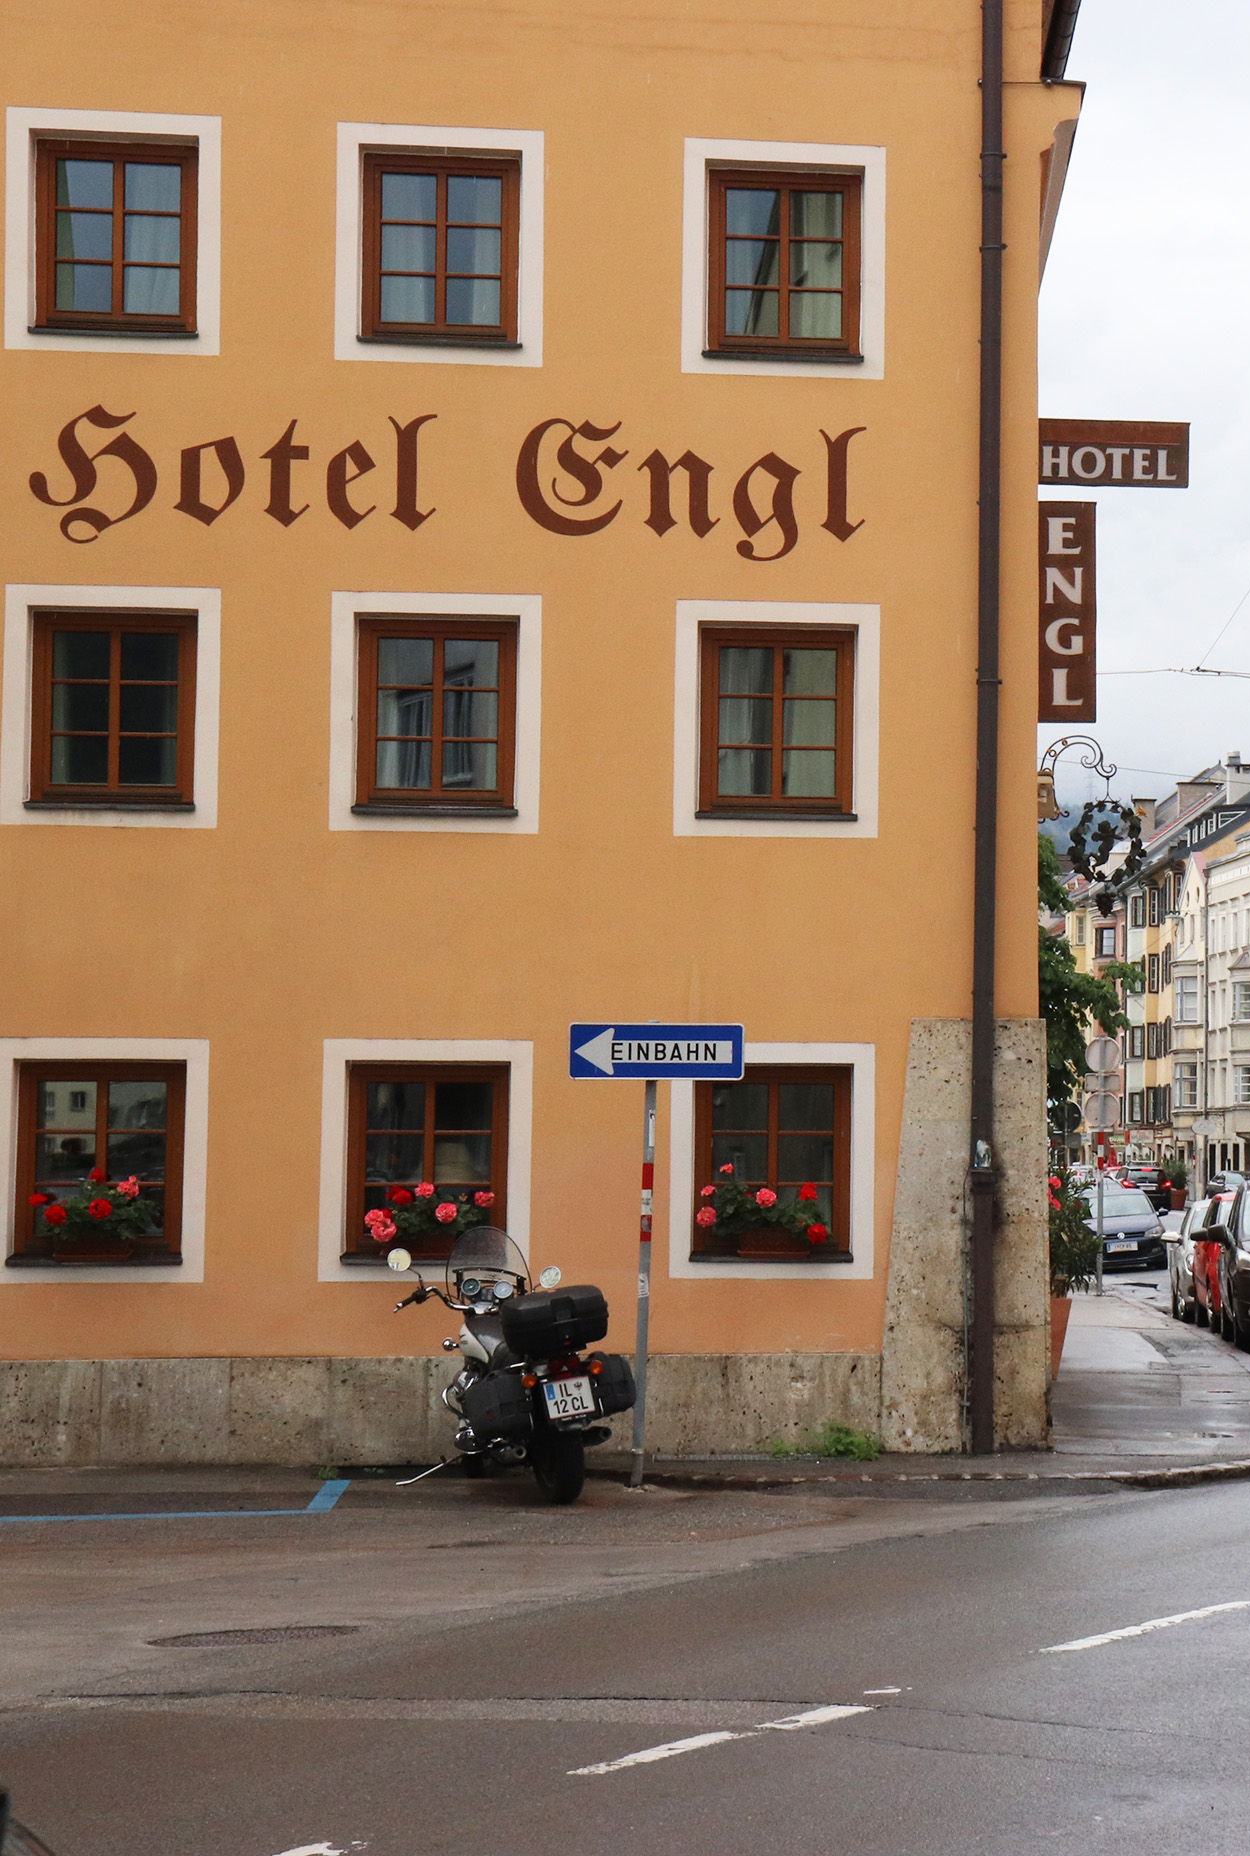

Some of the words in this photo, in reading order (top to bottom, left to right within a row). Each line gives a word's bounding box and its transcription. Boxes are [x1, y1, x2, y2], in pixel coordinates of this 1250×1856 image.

[1041, 445, 1178, 480] HOTEL
[28, 404, 438, 543] Hotel
[515, 418, 867, 561] Engl
[1044, 517, 1084, 706] ENGL
[611, 1043, 717, 1061] EINBAHN
[559, 1383, 572, 1398] IL
[553, 1399, 569, 1414] 12
[571, 1396, 589, 1411] CL
